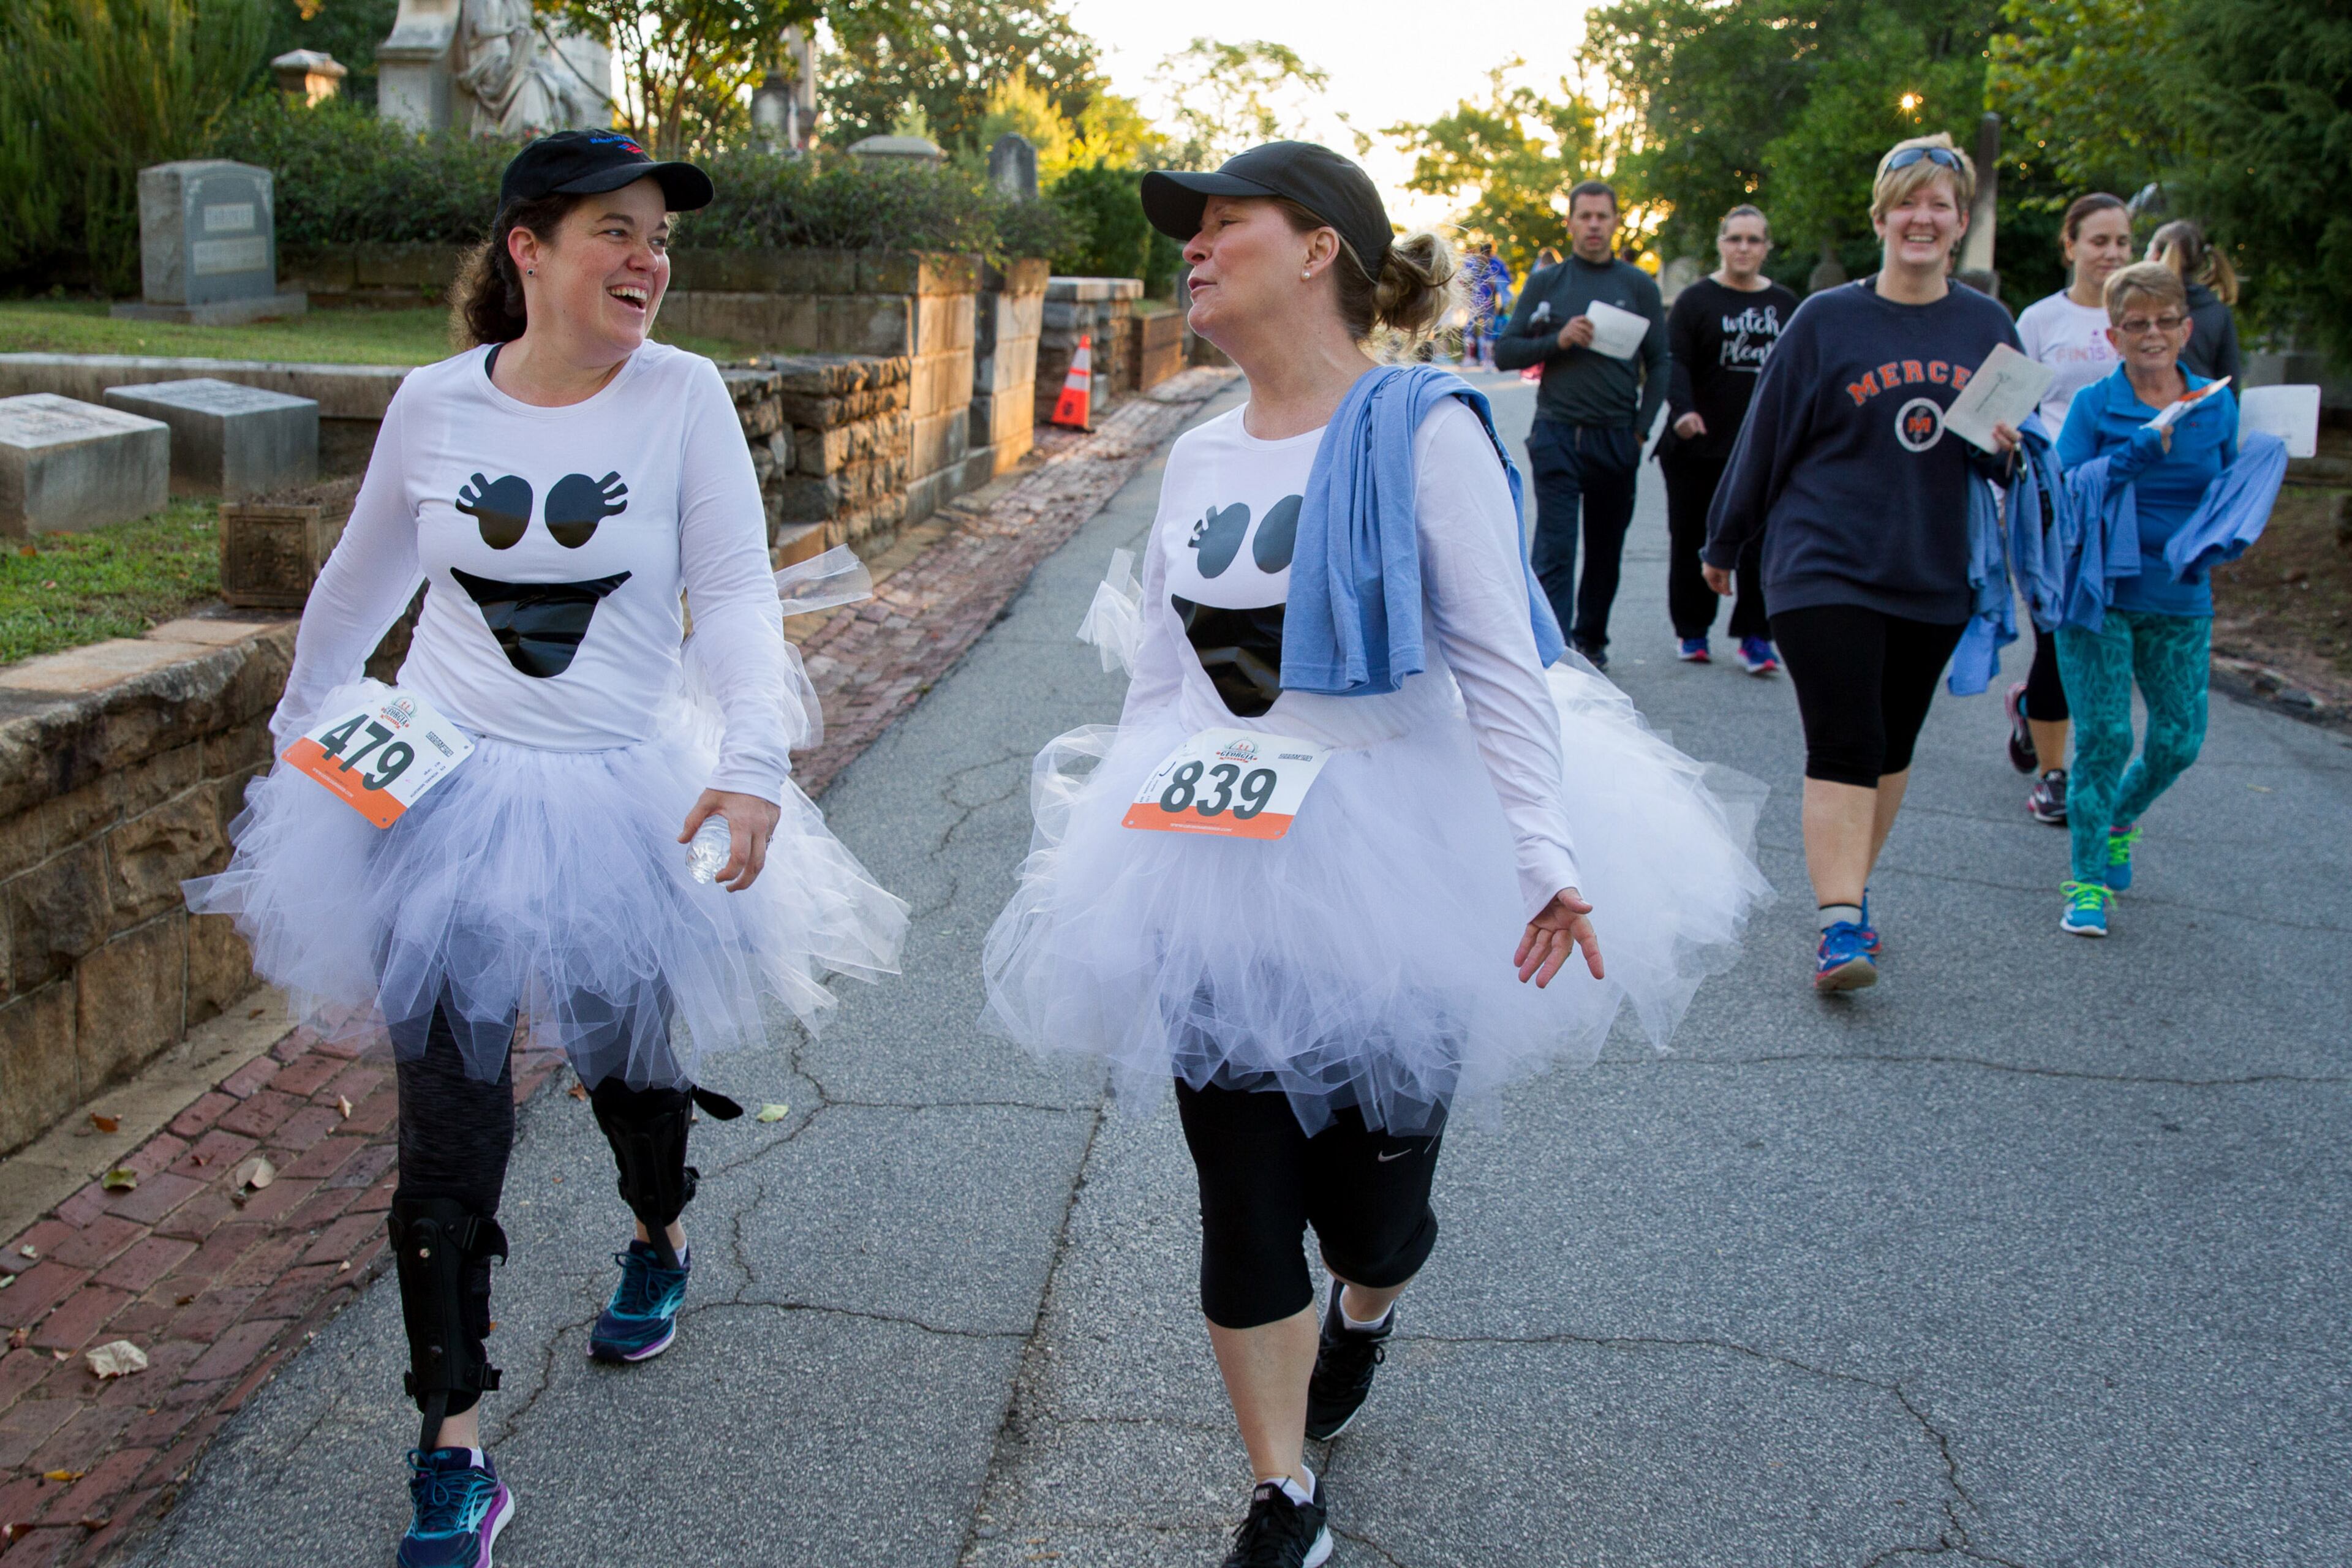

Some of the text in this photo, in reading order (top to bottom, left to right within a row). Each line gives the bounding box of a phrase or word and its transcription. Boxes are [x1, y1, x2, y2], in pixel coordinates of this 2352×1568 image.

[1722, 305, 1780, 337] witch
[1720, 331, 1776, 366] plea
[2056, 346, 2111, 362] FINIS
[1846, 360, 1972, 407] MERCE
[1907, 417, 1931, 434] M
[383, 706, 408, 727] GEORGIA
[318, 713, 415, 791] 479
[1220, 750, 1254, 761] GEORGIA
[1159, 760, 1277, 820] 839
